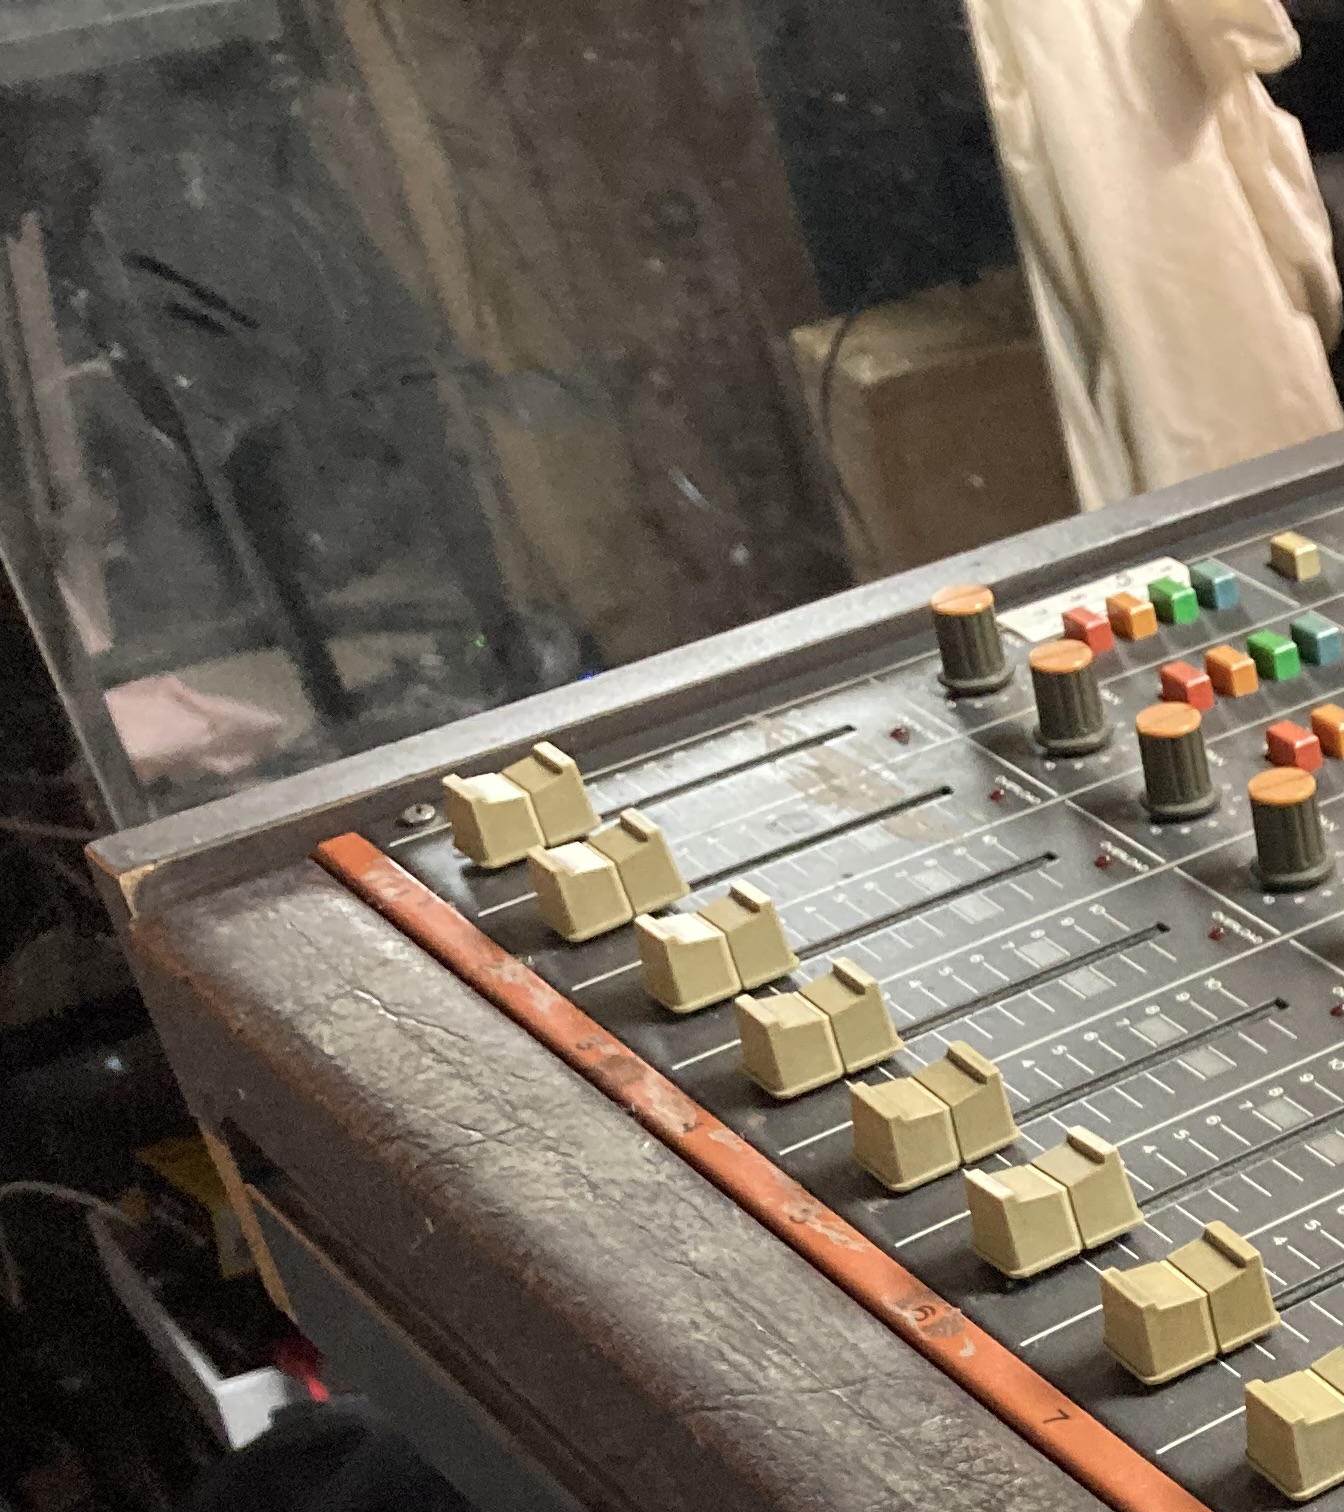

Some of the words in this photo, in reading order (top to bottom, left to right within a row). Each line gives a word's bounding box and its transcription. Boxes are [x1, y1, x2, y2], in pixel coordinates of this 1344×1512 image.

[1273, 1235, 1288, 1246] 4
[1304, 1218, 1321, 1231] 5
[1042, 1408, 1071, 1425] 7
